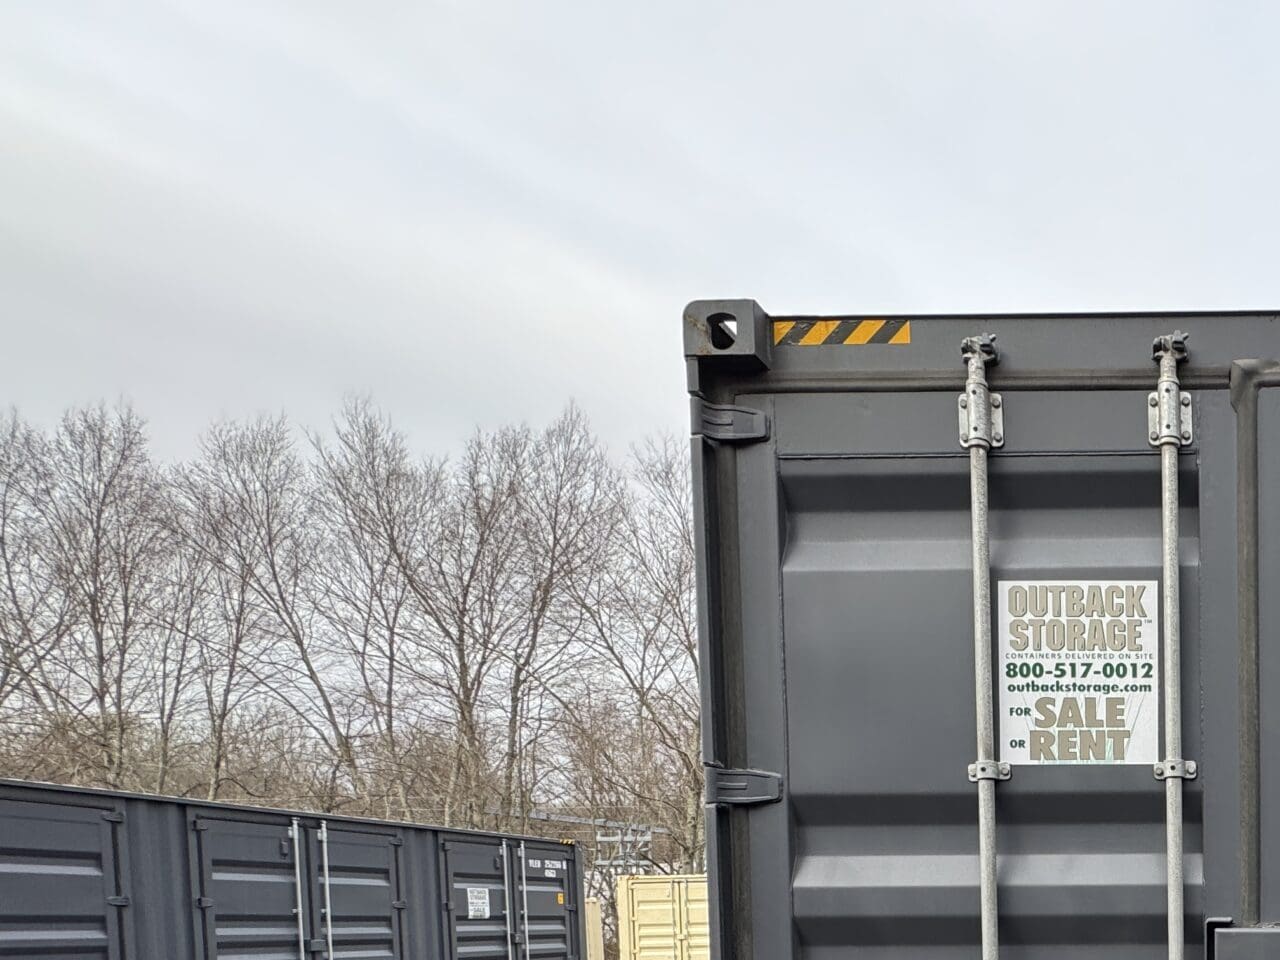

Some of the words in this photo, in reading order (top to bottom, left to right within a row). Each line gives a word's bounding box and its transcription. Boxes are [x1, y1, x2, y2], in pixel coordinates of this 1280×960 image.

[1007, 585, 1148, 618] OUTBACK
[1008, 618, 1143, 651] STORAGE
[1005, 652, 1062, 660] CONTAINERS
[1065, 652, 1115, 660] DELIVERED
[1118, 652, 1131, 660] ON
[1134, 652, 1154, 660] SITE
[1005, 662, 1154, 679] 800-517-0012
[1007, 680, 1153, 695] outbackstorage.com
[1009, 707, 1032, 717] FOR
[1034, 696, 1126, 729] SALE
[1009, 739, 1026, 749] OR
[1029, 729, 1131, 761] RENT
